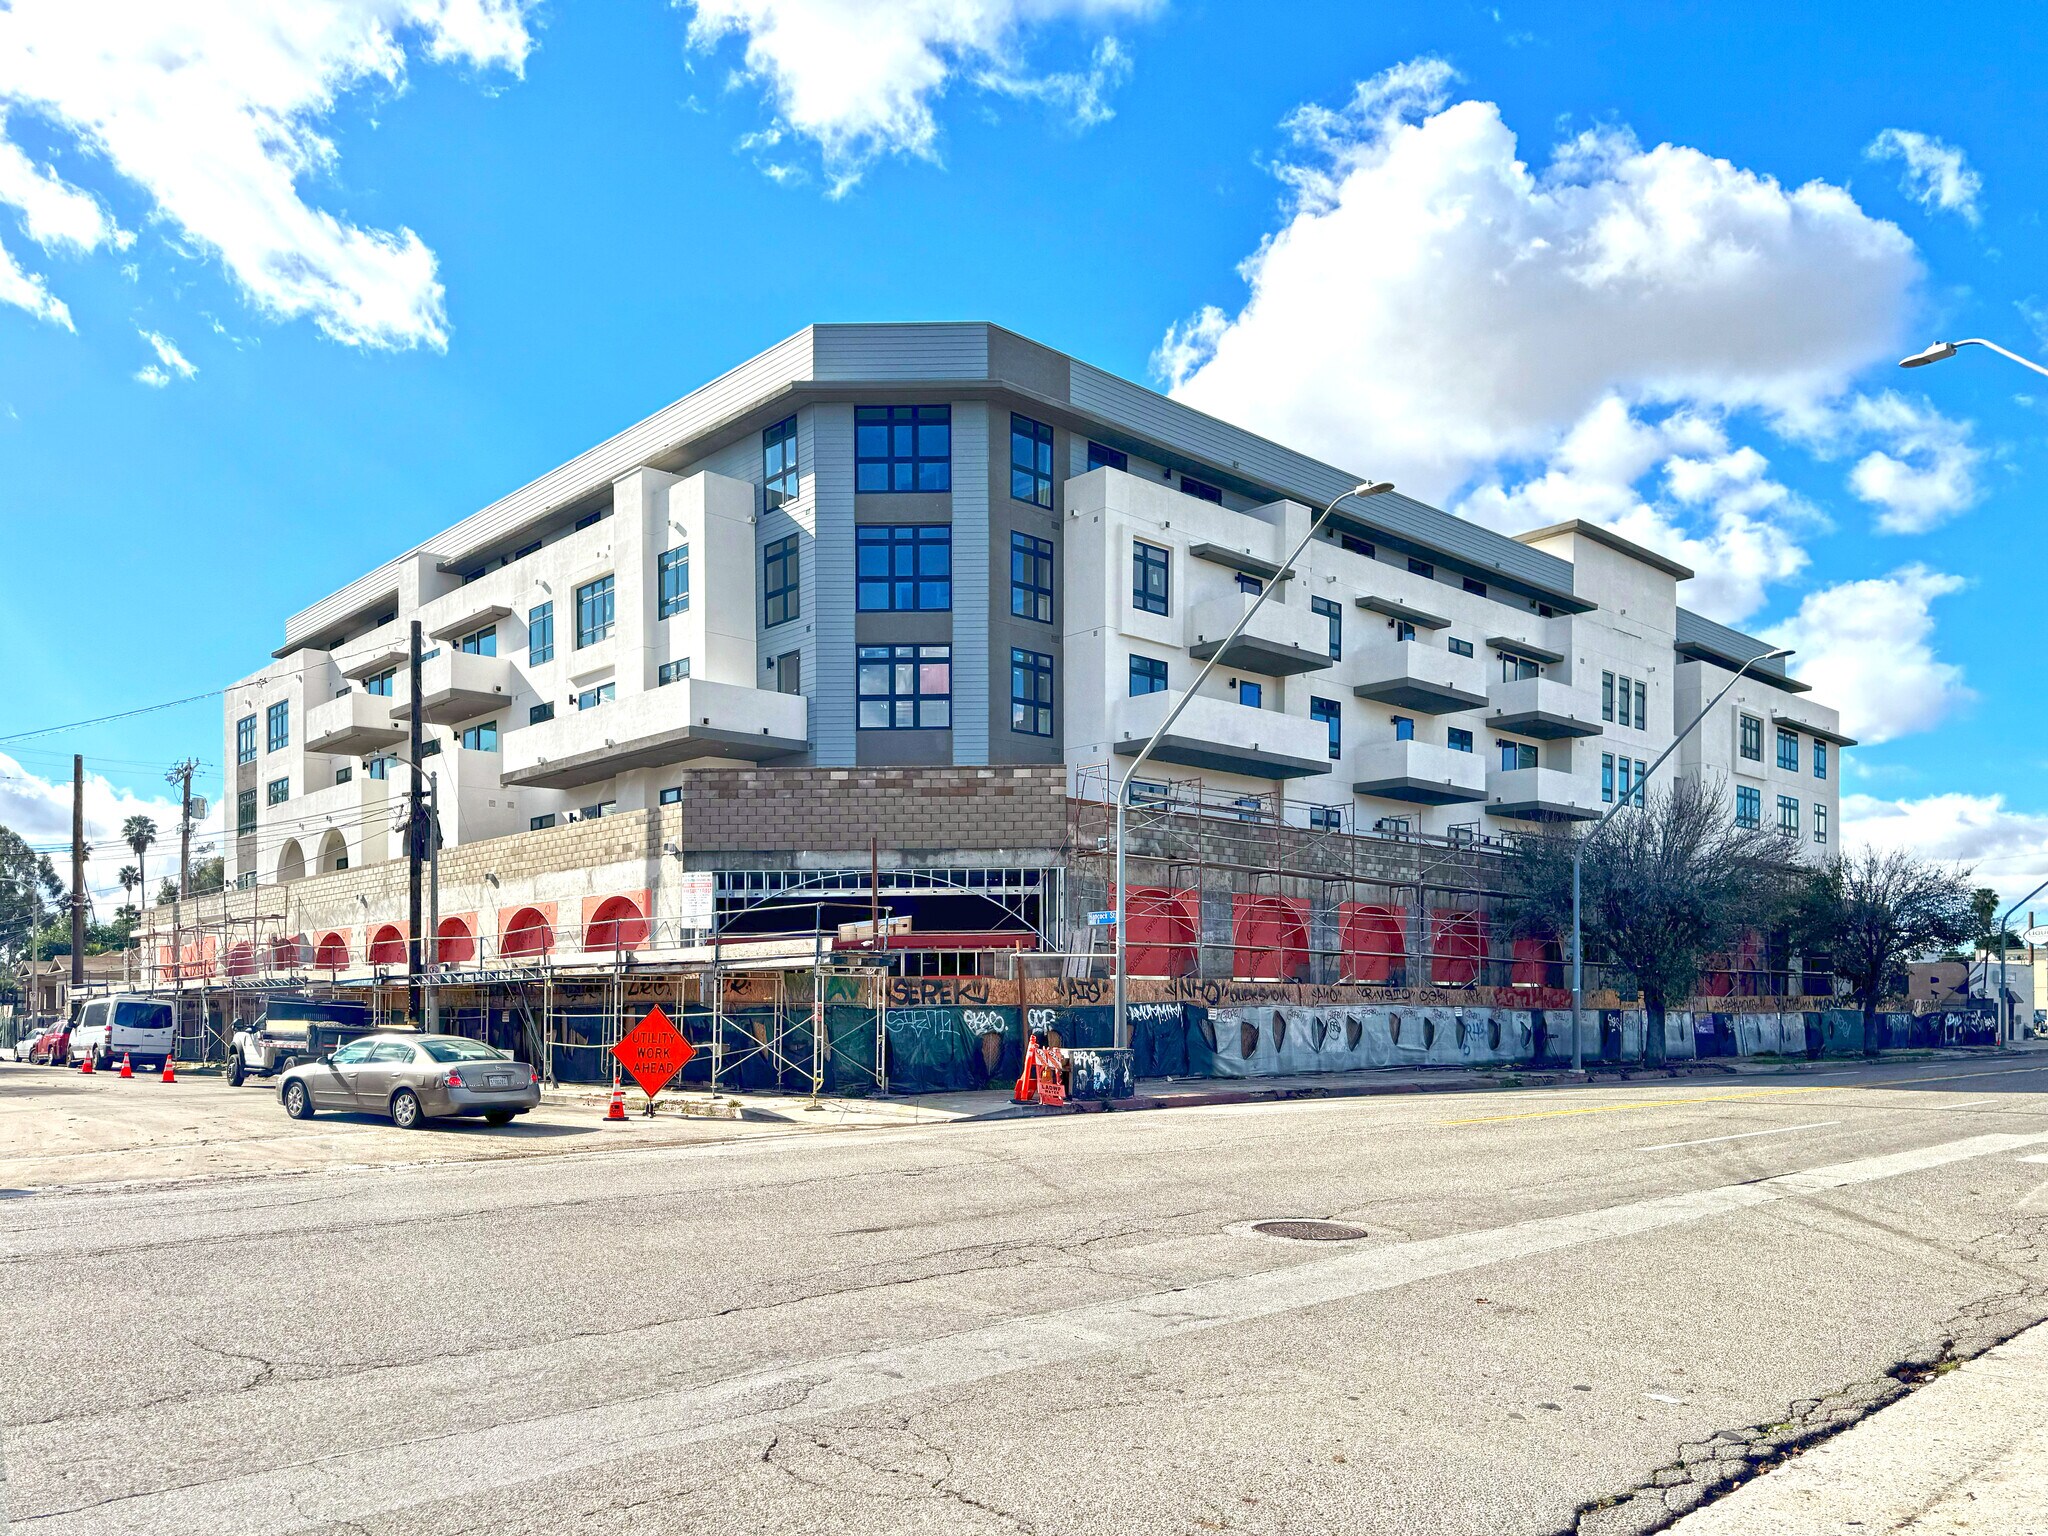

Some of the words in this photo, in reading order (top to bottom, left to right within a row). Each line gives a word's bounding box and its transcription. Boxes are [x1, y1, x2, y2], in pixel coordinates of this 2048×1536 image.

[632, 1032, 676, 1044] UTILITY
[637, 1047, 671, 1059] WORK
[632, 1062, 674, 1073] AHEAD
